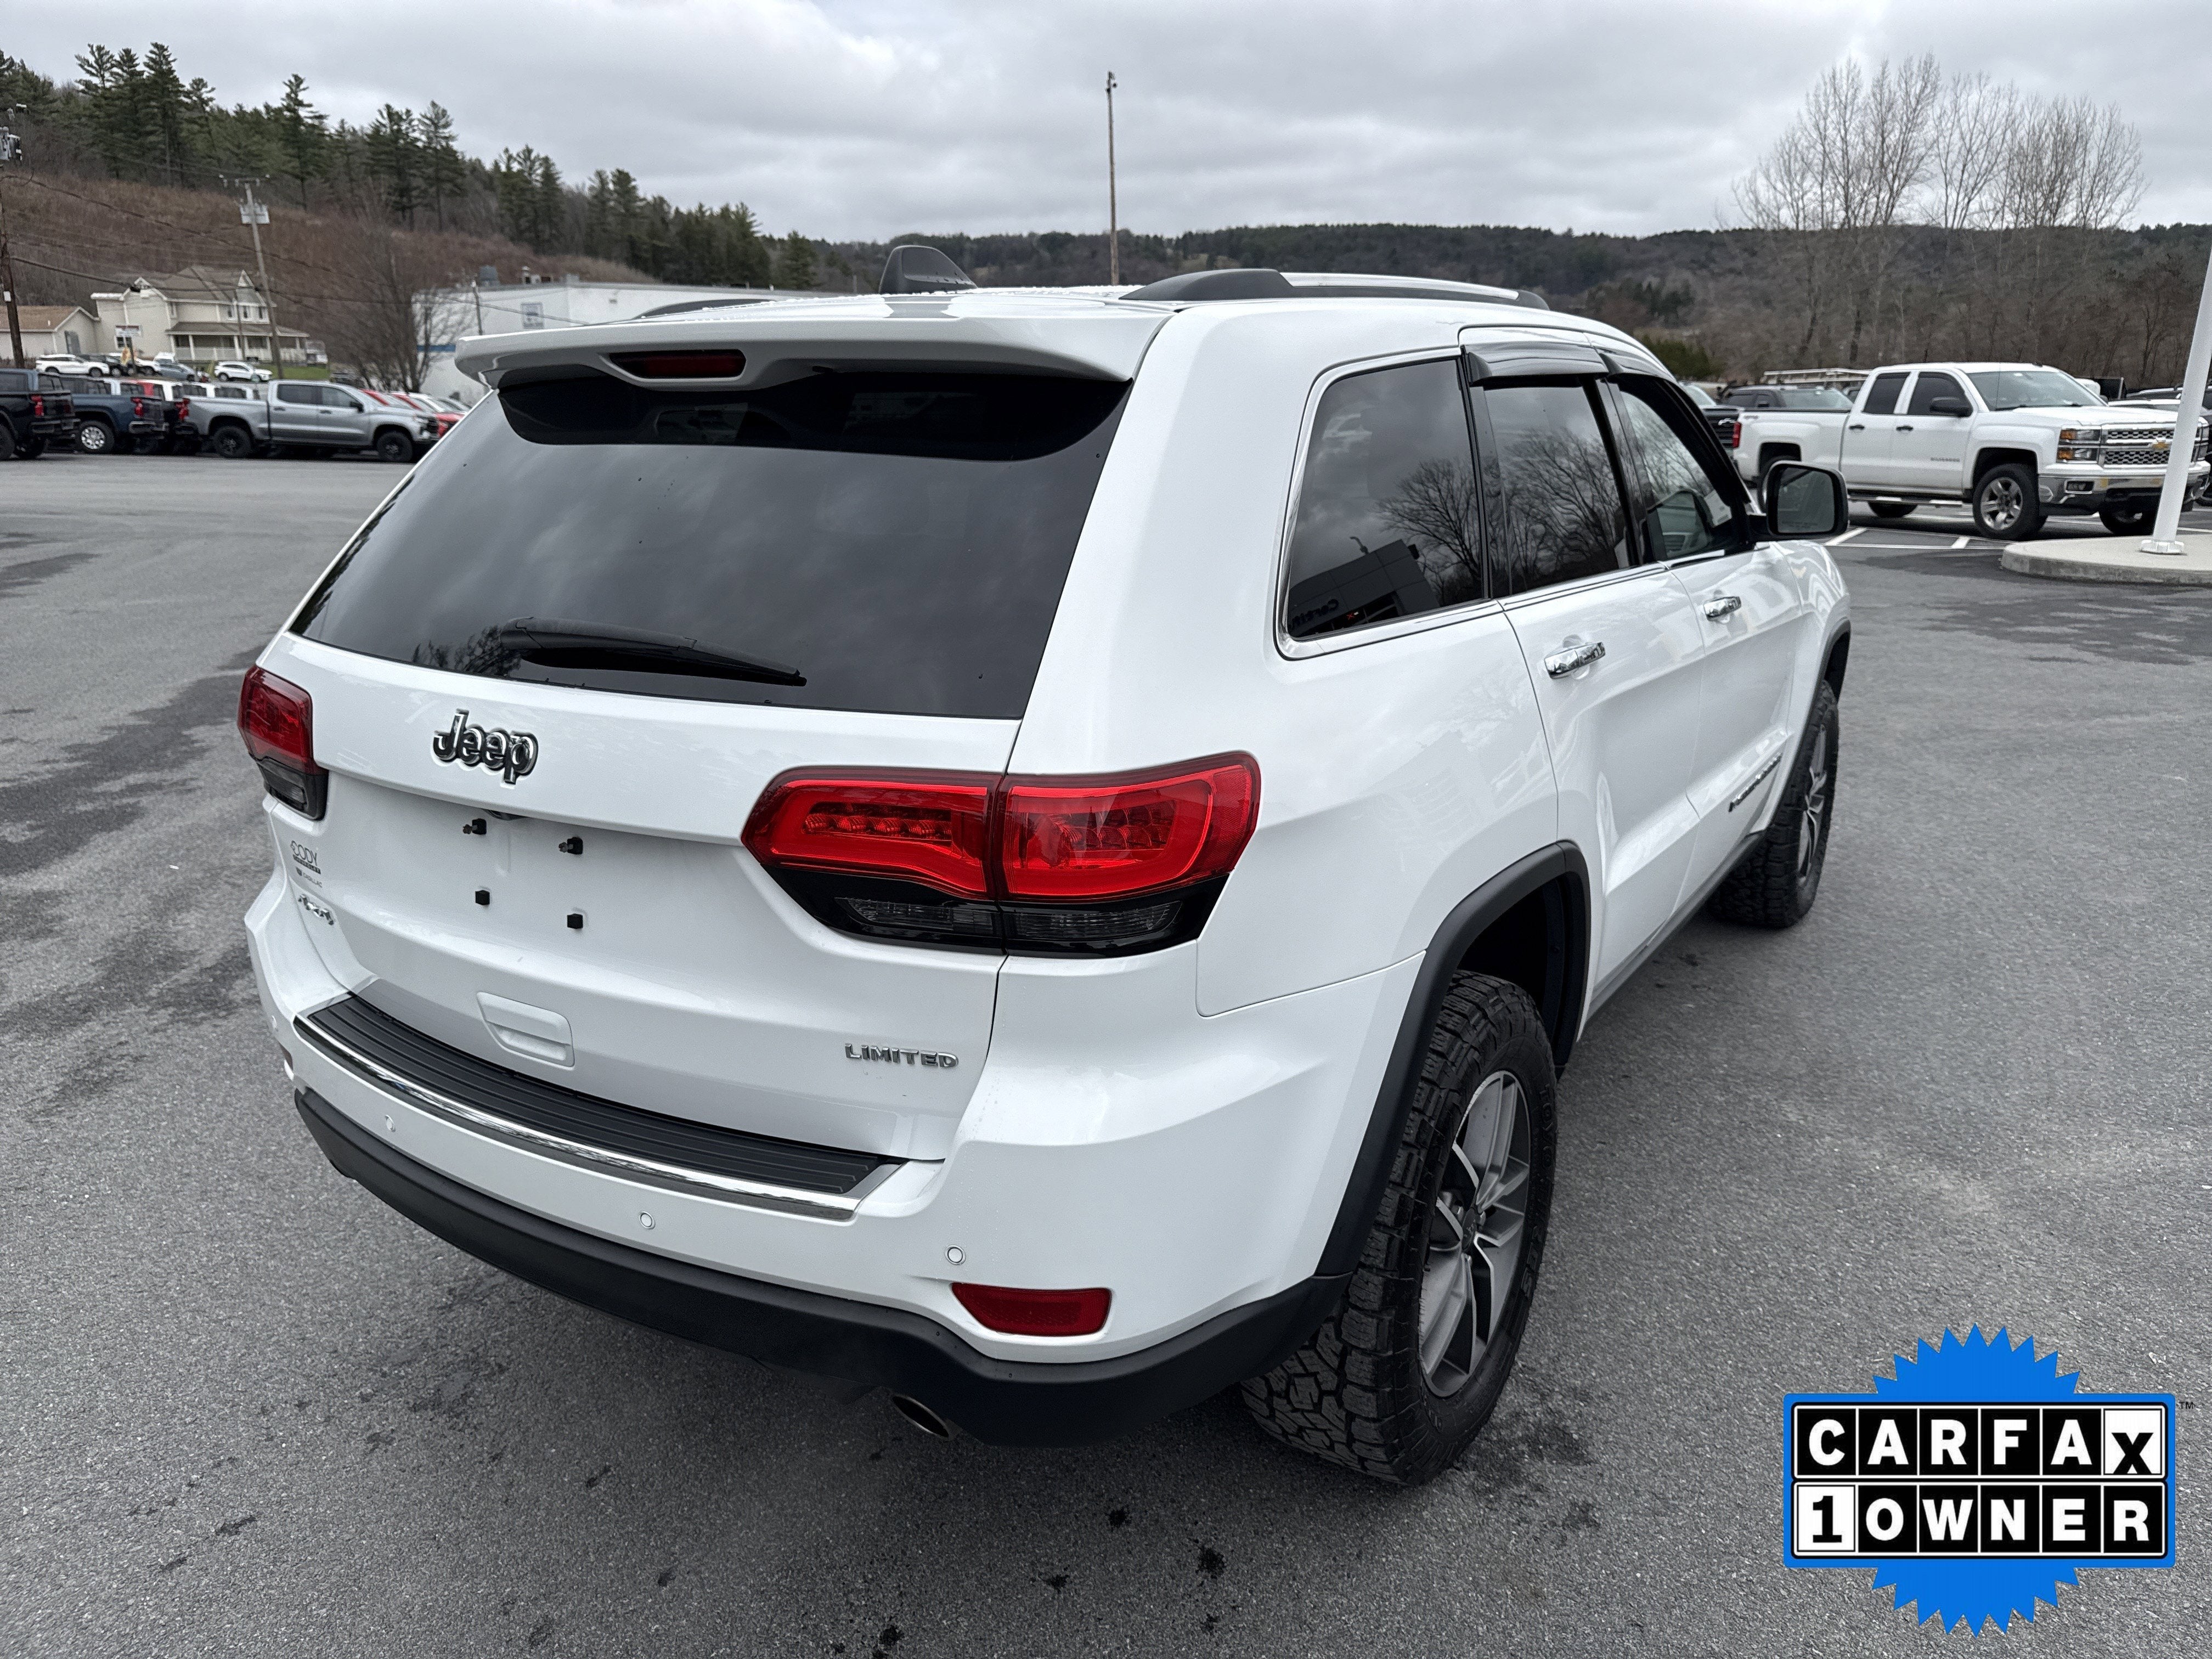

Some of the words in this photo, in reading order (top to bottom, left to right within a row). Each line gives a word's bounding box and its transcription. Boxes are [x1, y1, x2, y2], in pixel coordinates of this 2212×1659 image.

[433, 708, 539, 786] Jeep
[290, 840, 318, 866] CODY
[844, 1043, 960, 1068] LIMITED
[1539, 1082, 1555, 1170] TOYO
